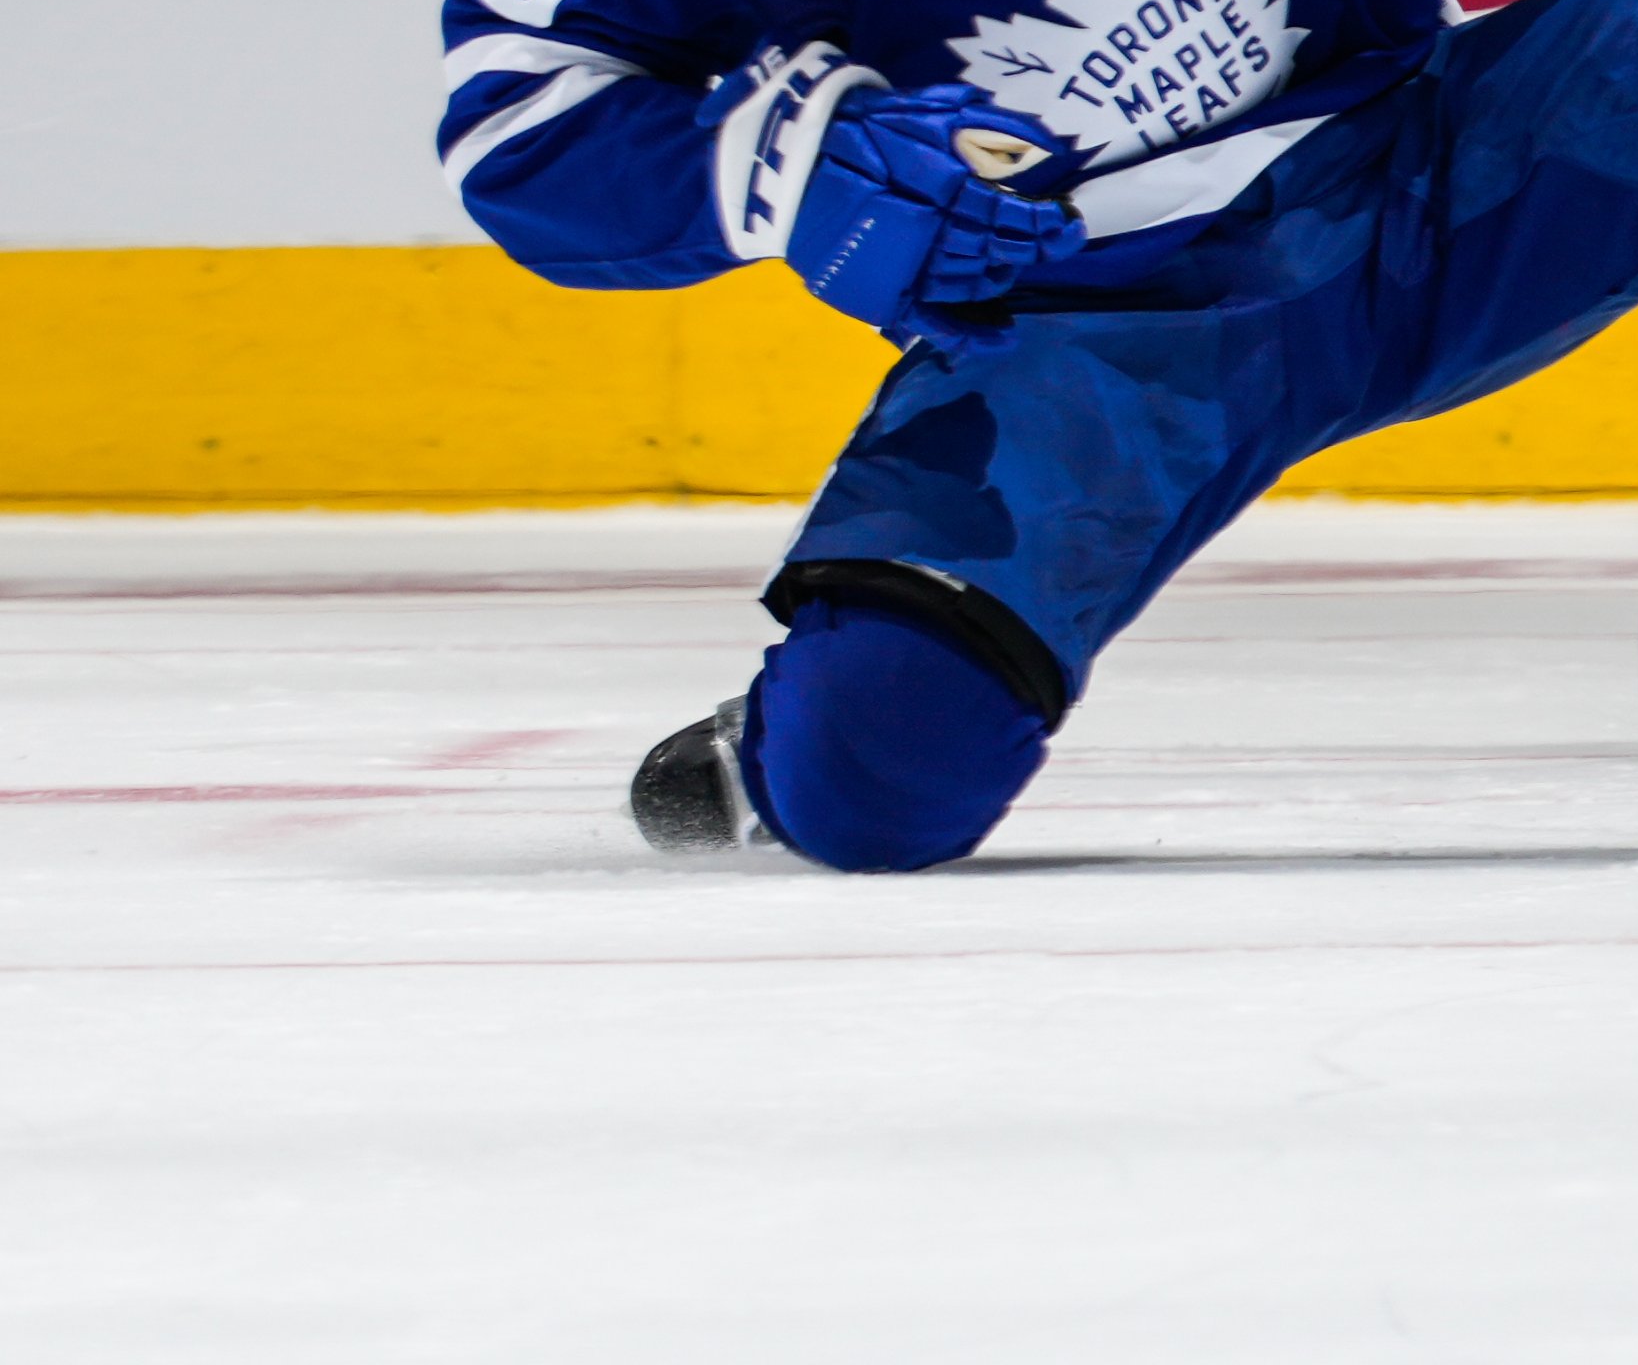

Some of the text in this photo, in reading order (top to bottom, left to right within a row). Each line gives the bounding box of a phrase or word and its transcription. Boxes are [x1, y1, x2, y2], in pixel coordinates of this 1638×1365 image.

[1113, 0, 1251, 124] MAPLE
[1139, 35, 1272, 153] LEAFS
[743, 52, 850, 235] TRU
